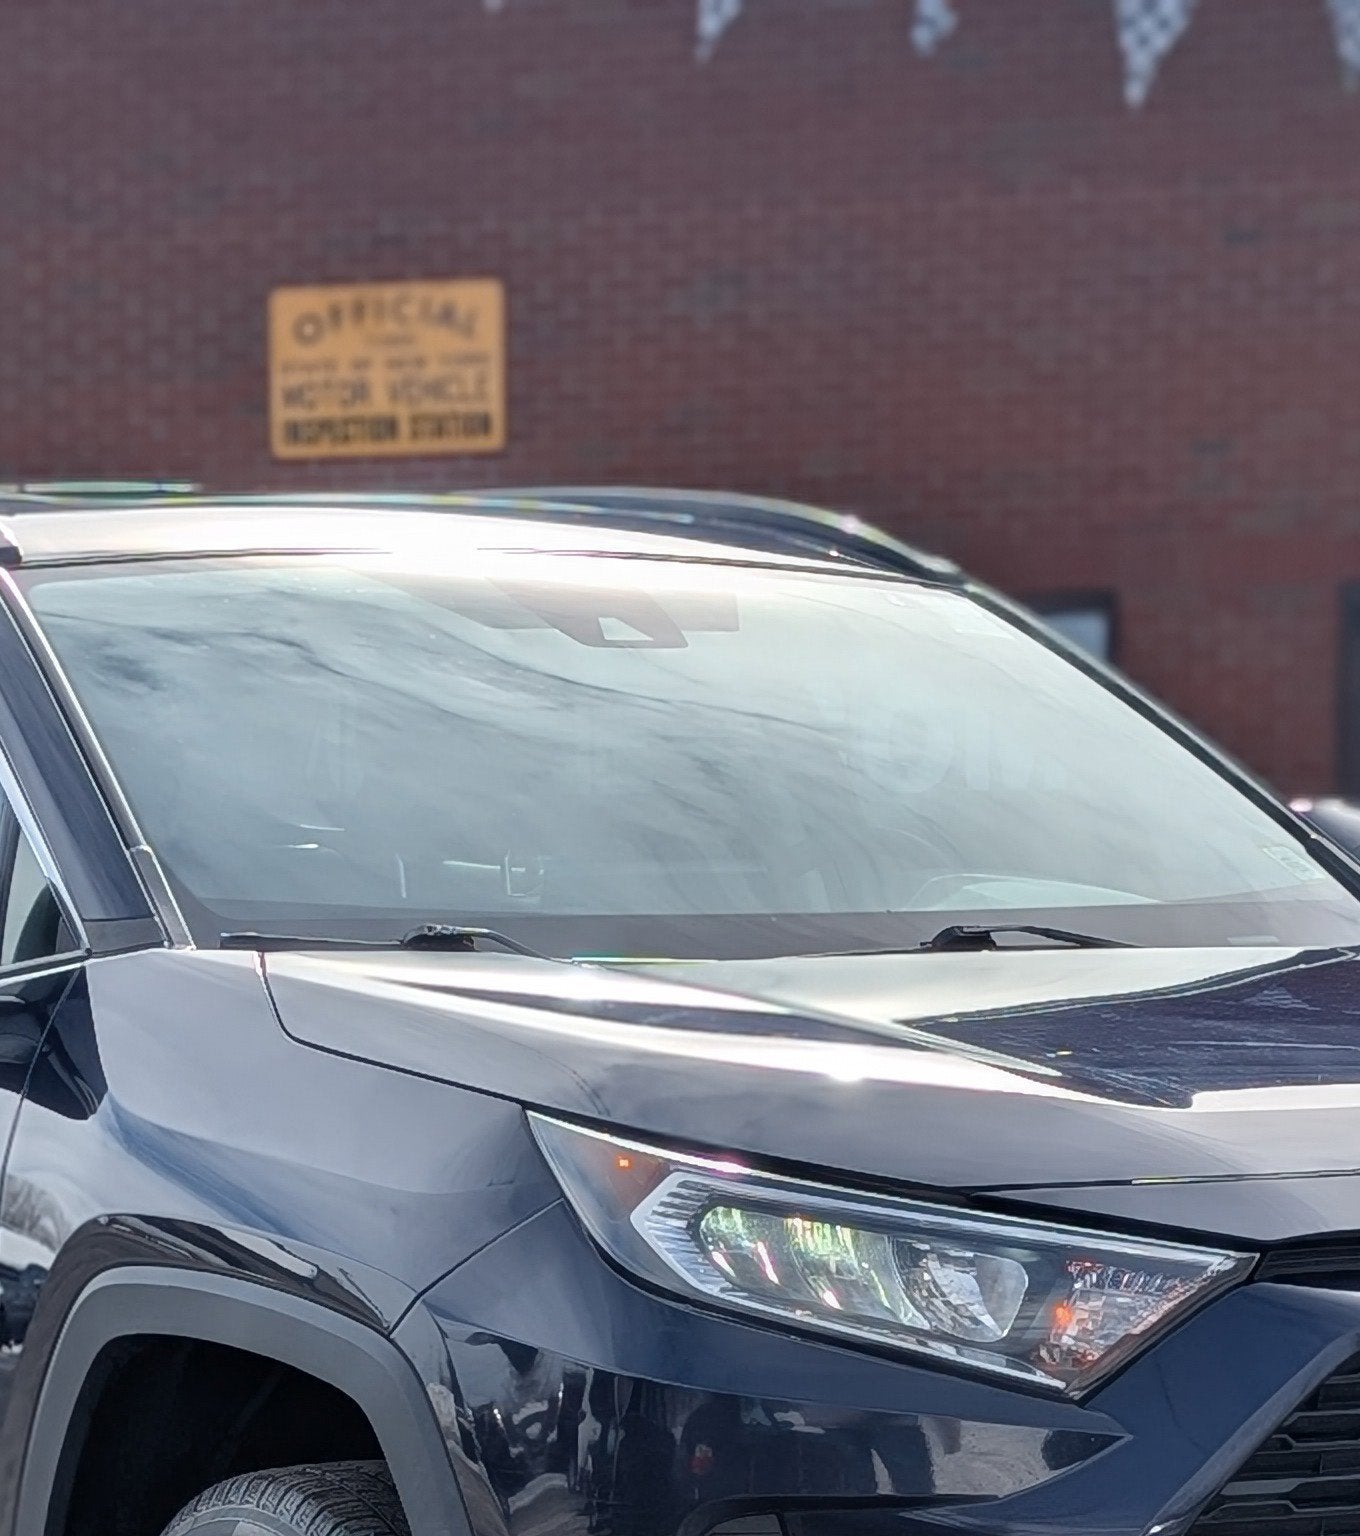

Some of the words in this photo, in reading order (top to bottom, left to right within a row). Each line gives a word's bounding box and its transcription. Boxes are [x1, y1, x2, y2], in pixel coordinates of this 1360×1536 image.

[292, 296, 476, 347] OFFICIAL
[283, 381, 370, 409] MOTOR
[285, 416, 399, 445] INSPECTION
[409, 412, 491, 440] STATION
